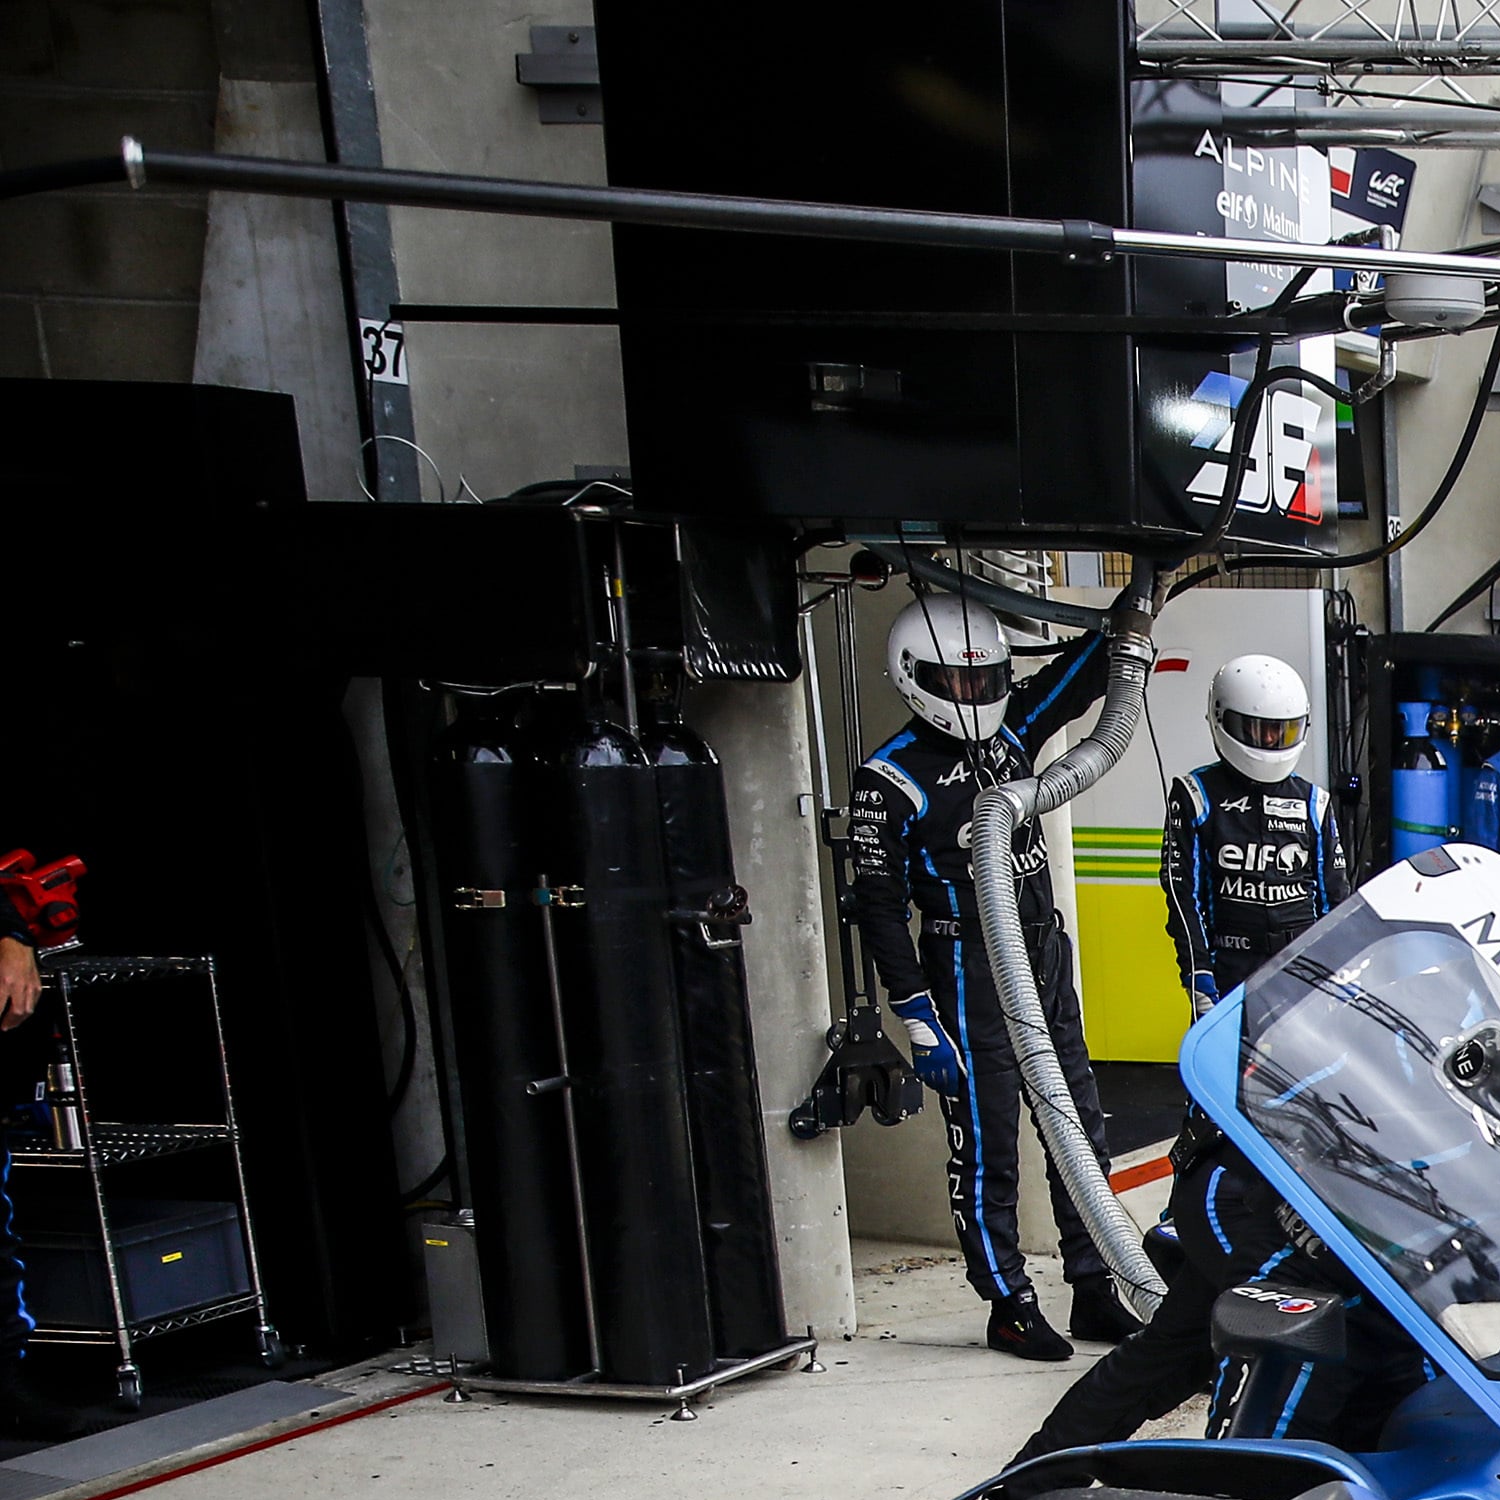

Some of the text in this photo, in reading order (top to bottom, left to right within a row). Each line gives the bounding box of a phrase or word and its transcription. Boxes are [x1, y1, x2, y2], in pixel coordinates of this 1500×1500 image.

[1369, 170, 1406, 198] WEC
[1216, 190, 1245, 223] elf
[362, 327, 404, 379] 37
[1218, 843, 1276, 872] elf
[1220, 876, 1308, 901] Matmut
[1231, 1286, 1290, 1311] elf
